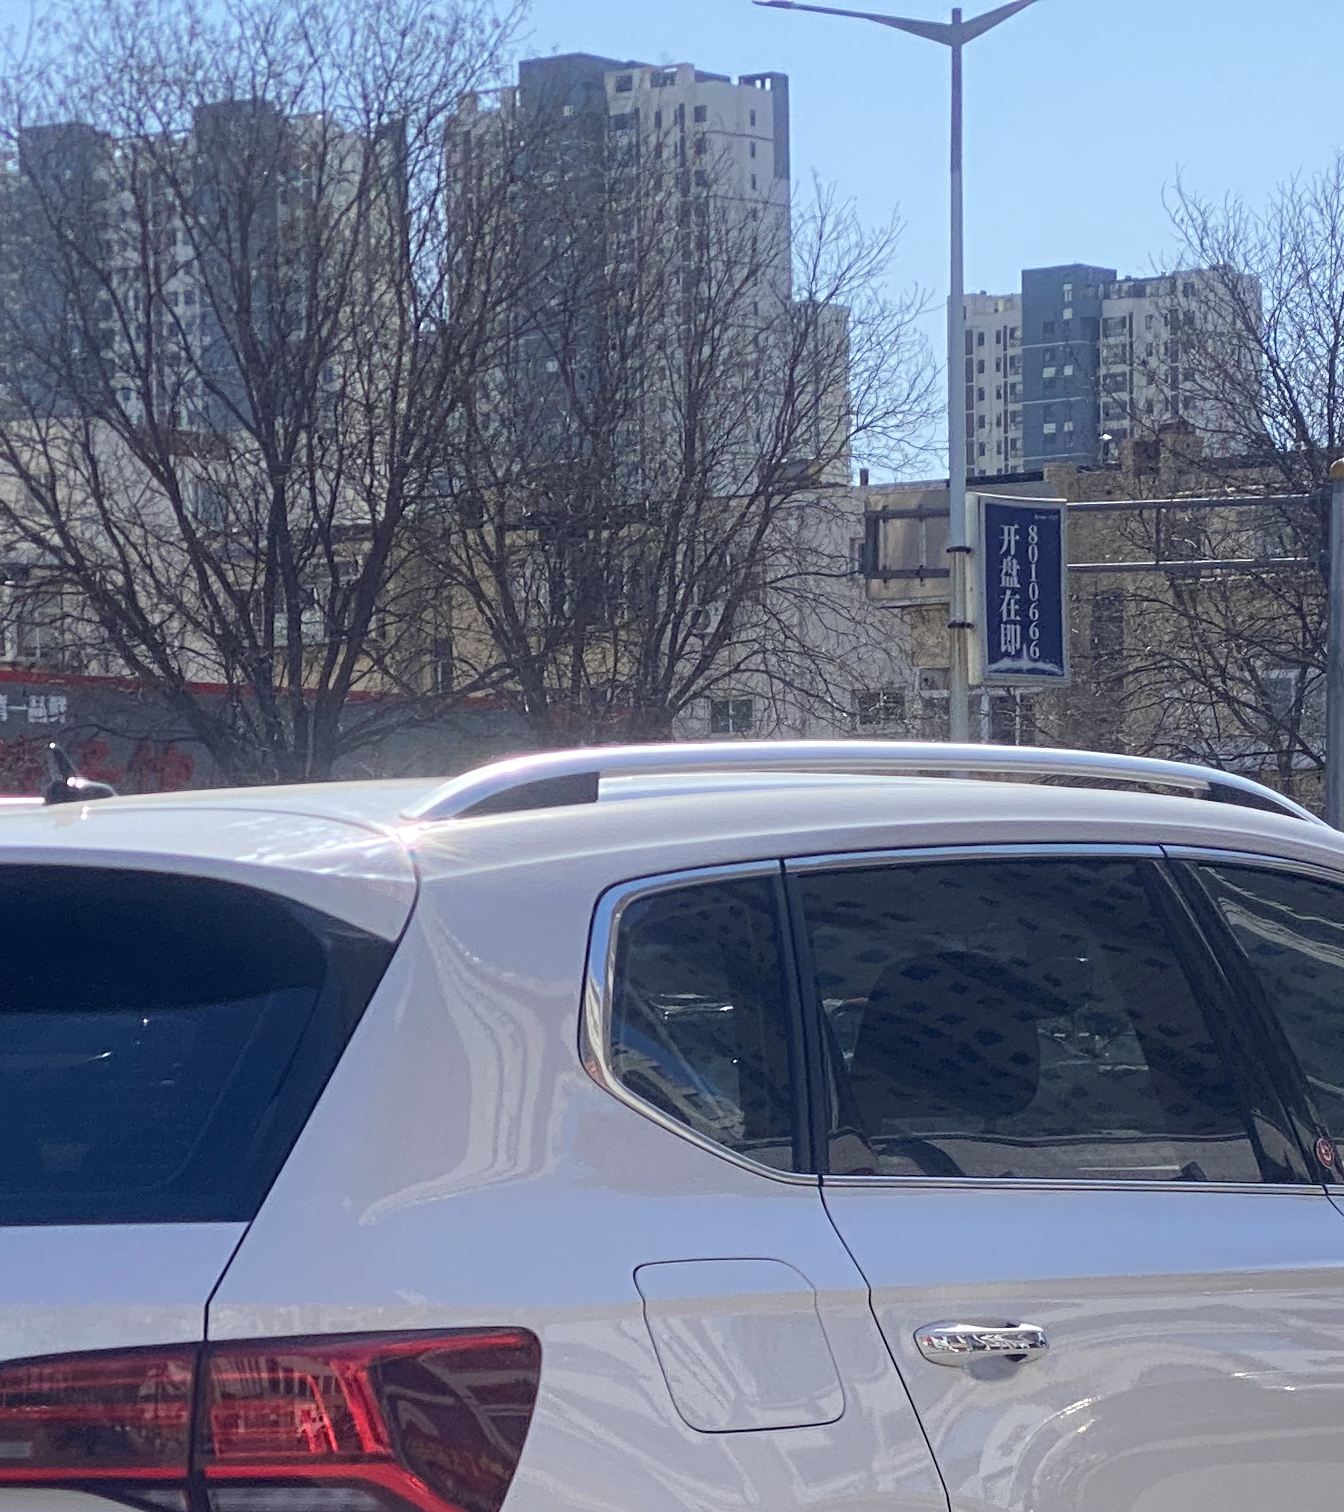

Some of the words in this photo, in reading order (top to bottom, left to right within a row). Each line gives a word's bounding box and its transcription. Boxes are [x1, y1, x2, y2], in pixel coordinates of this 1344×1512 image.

[998, 523, 1022, 656] 开盘在即
[1027, 524, 1040, 659] 8010666
